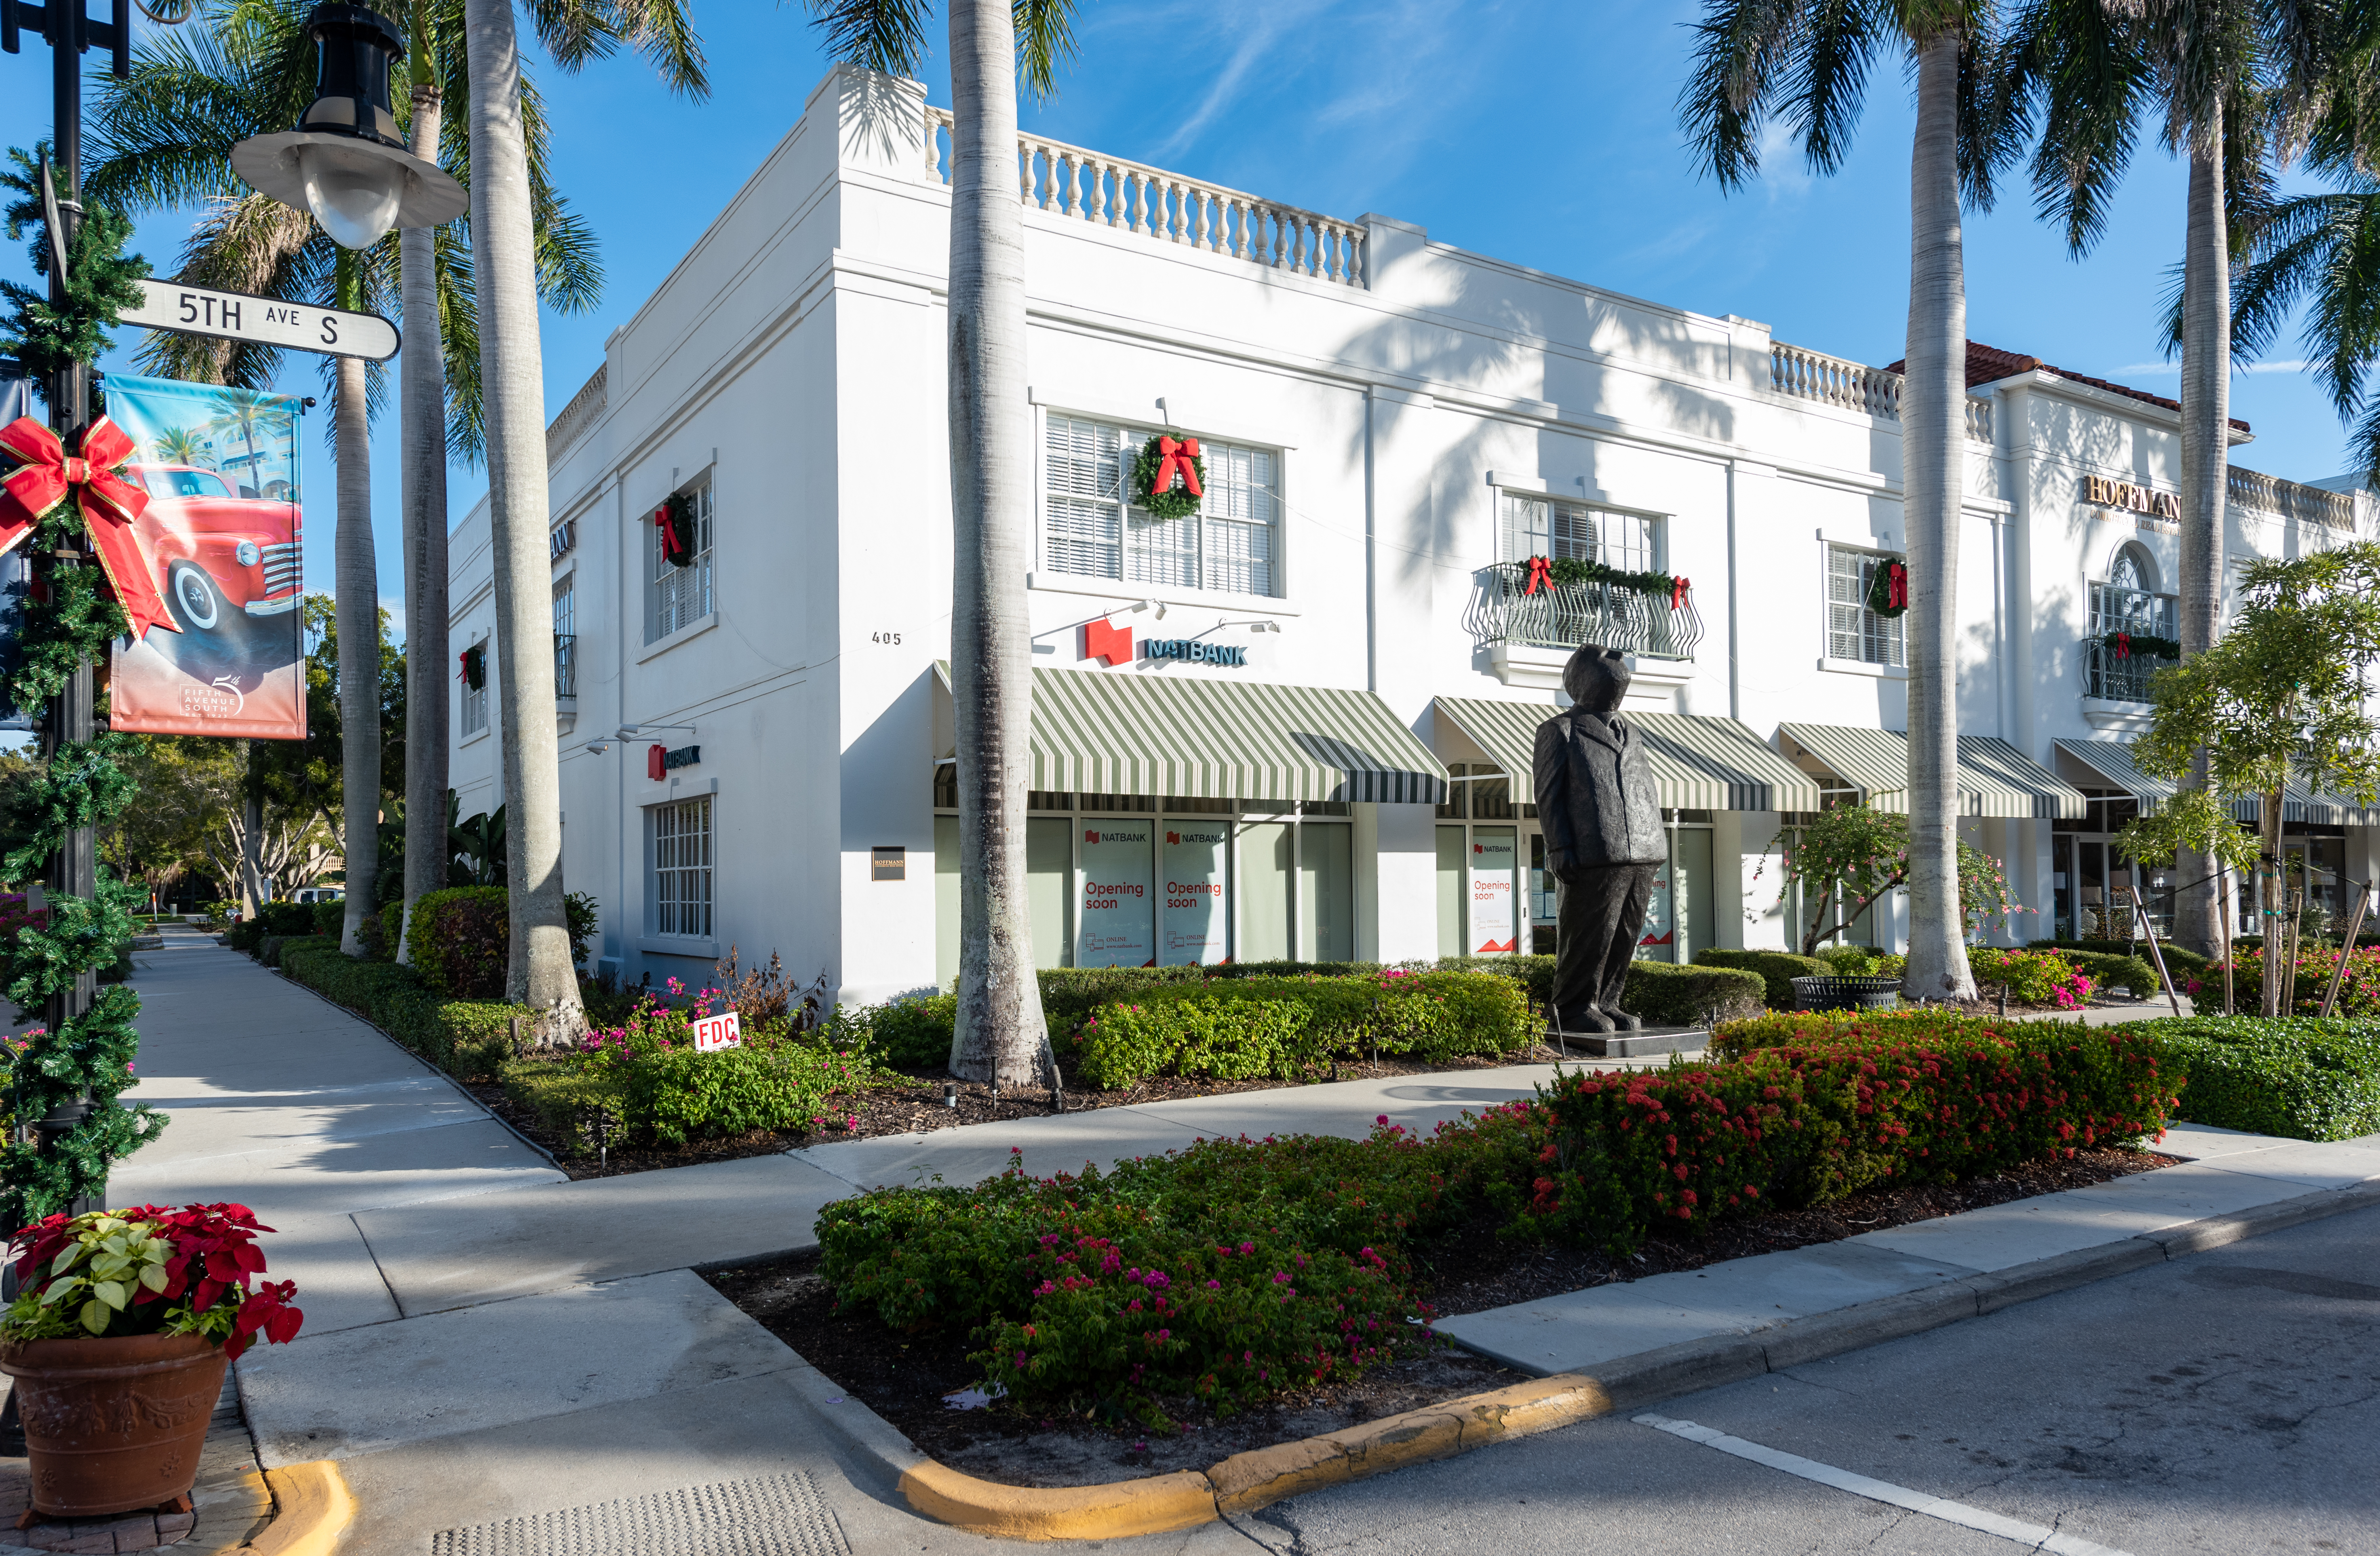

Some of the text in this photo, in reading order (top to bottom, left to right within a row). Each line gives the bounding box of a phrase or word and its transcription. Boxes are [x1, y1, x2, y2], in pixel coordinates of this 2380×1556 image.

[179, 293, 338, 344] 5TH AVE S
[2085, 475, 2181, 519] HOFFMAN
[2090, 509, 2181, 537] COMMERCIL REAL ESTAT
[872, 631, 901, 645] 405
[1146, 638, 1248, 666] NATBANK
[185, 697, 235, 705] AVENUE
[664, 746, 695, 770] NATBANK
[1102, 833, 1146, 842] NATBANK
[1182, 834, 1224, 843] NATBANK
[1086, 881, 1143, 898] Opening
[1167, 881, 1221, 897] Opening
[1475, 881, 1510, 892] Opening
[1086, 899, 1117, 909] soon
[1167, 898, 1197, 908] soon
[699, 1017, 734, 1047] FDC
